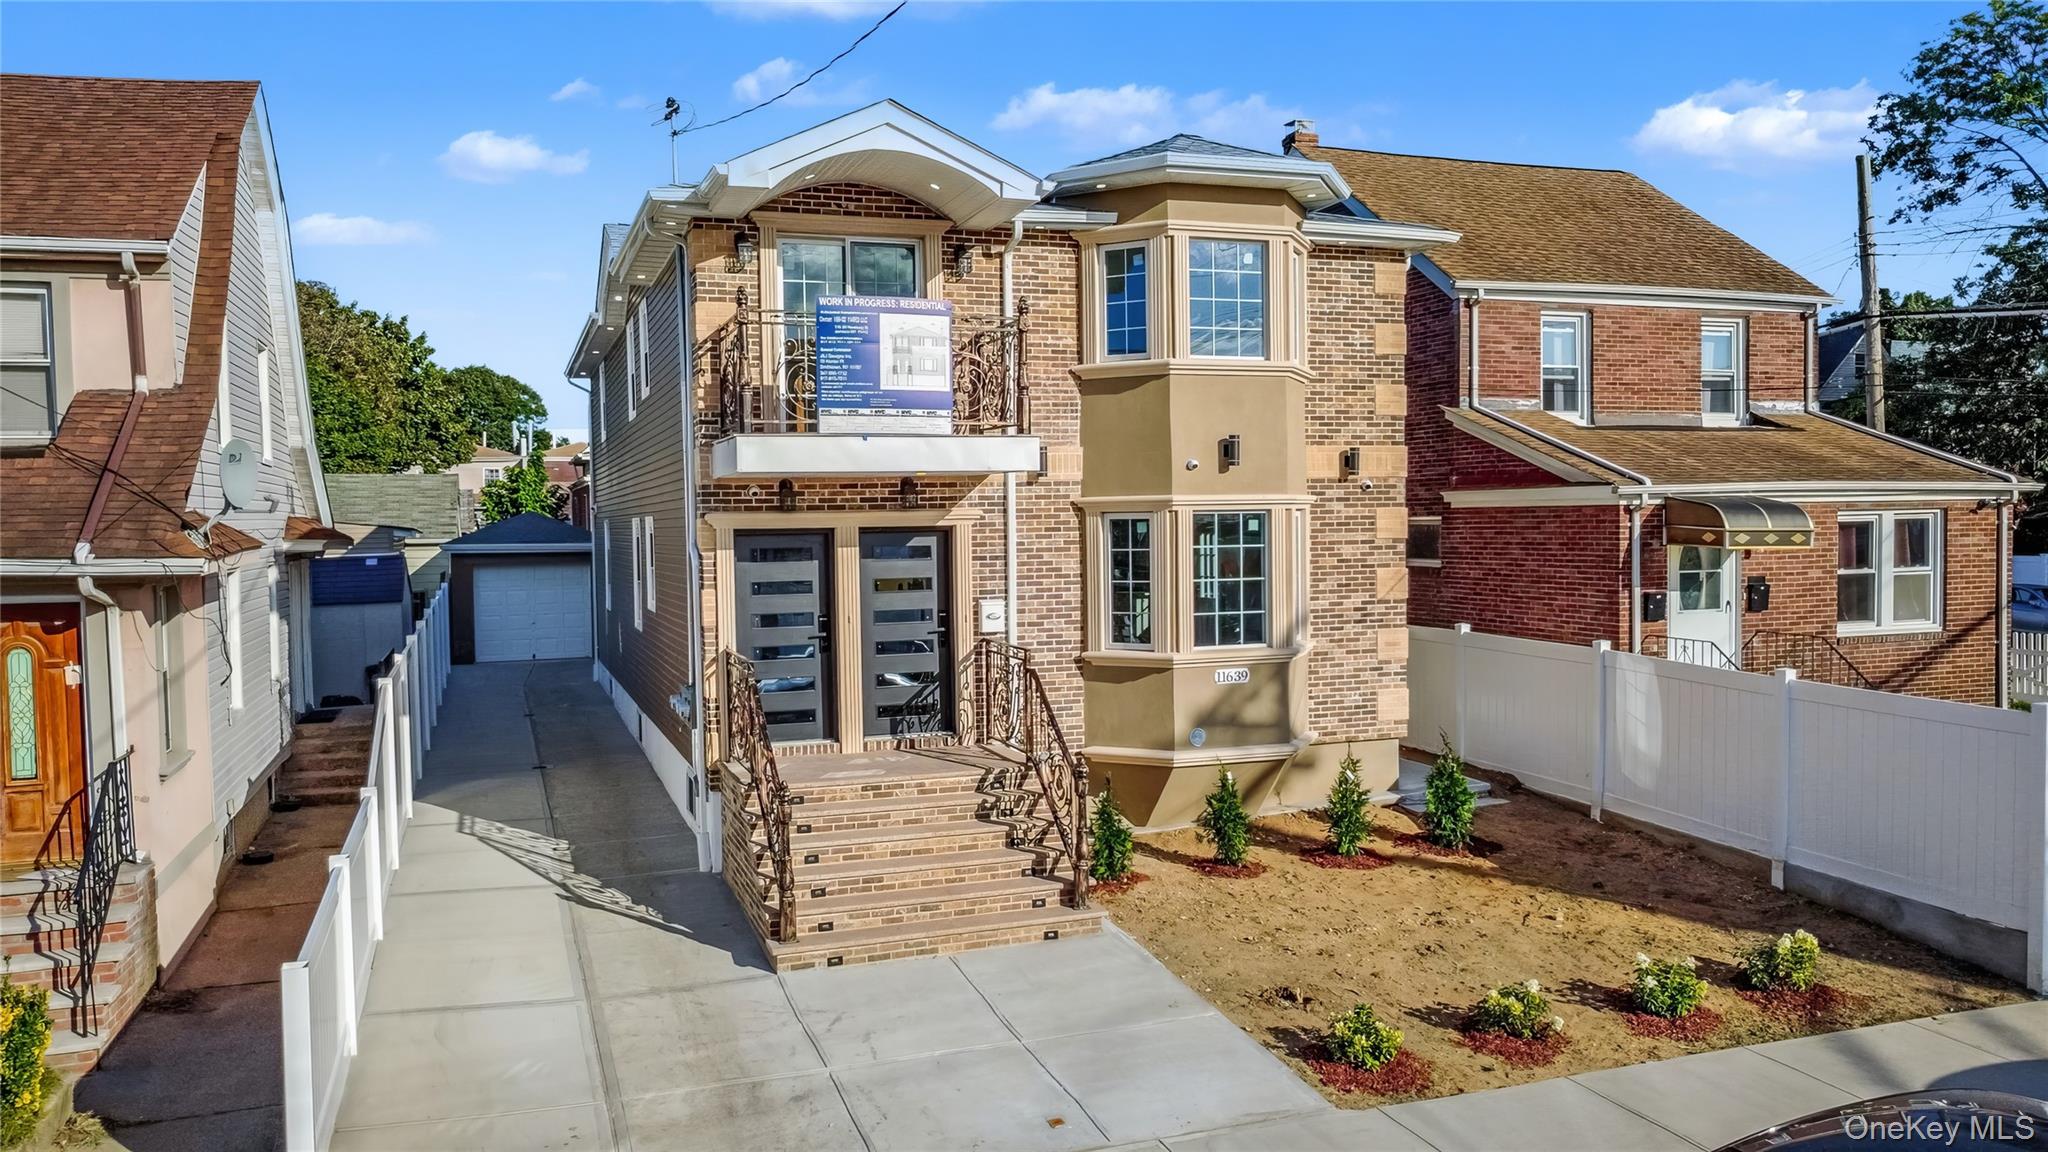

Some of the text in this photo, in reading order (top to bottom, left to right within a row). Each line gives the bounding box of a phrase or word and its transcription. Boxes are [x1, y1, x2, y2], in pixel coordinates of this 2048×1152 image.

[818, 297, 946, 310] WORK IN PROGRESS: RESIDENTIAL
[1217, 670, 1248, 682] 11639
